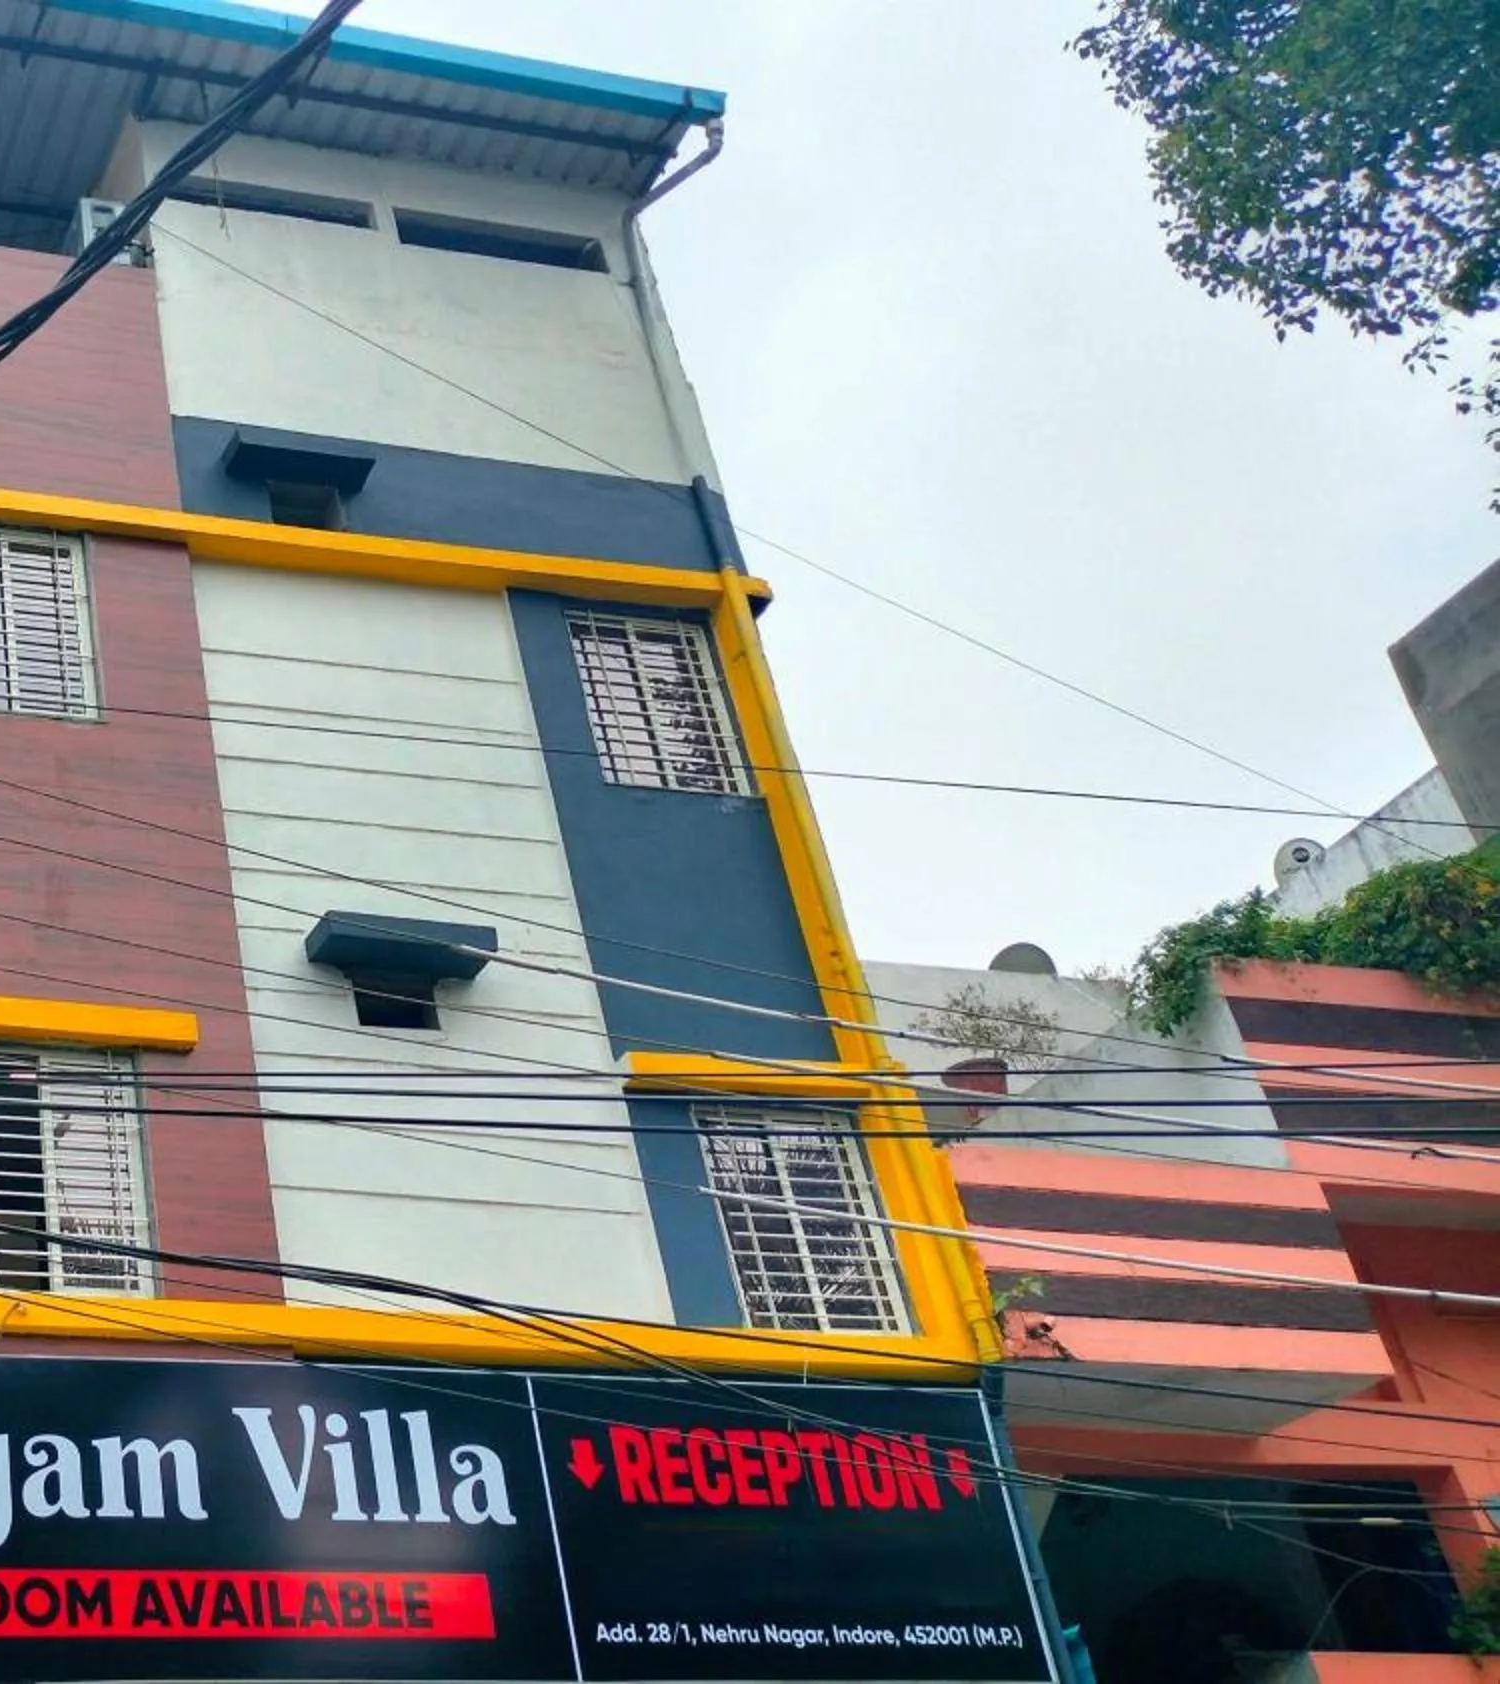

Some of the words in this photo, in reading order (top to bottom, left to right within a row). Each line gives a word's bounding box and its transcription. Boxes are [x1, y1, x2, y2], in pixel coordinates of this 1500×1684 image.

[231, 1405, 517, 1525] Villa
[608, 1423, 944, 1511] RECEPTION
[131, 1577, 434, 1629] AVAILABLE
[596, 1622, 643, 1643] Add.
[646, 1621, 698, 1646] 28/1,
[700, 1624, 760, 1643] Nehru
[762, 1624, 830, 1649] Nagar,
[832, 1624, 901, 1647] Indore,
[904, 1625, 970, 1646] 452001
[972, 1623, 1023, 1649] (M.P.)
